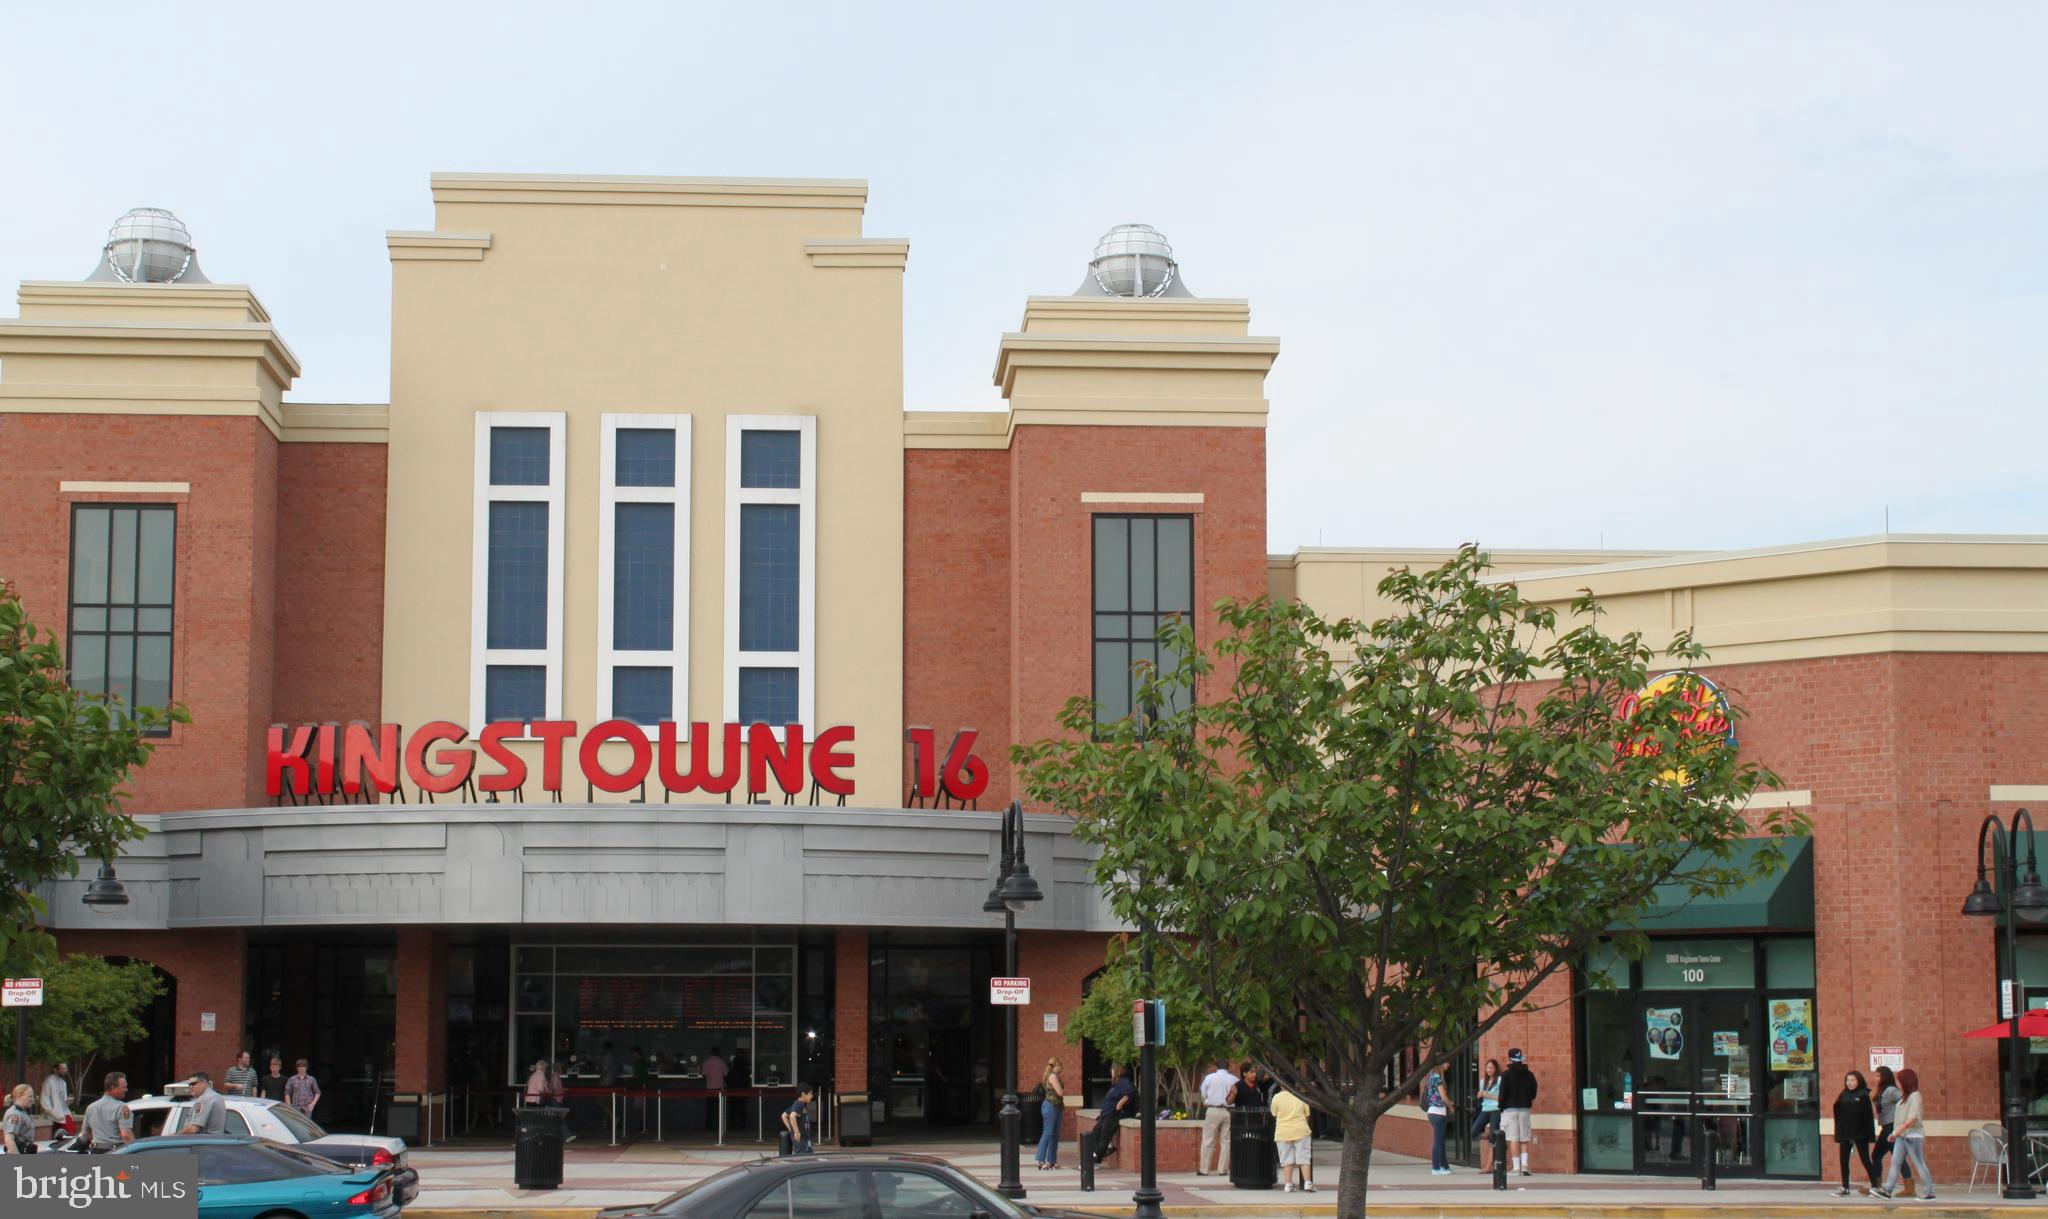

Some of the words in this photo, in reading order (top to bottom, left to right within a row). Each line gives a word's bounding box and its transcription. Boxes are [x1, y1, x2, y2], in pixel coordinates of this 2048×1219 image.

[266, 720, 855, 796] KINGSTOWNE
[906, 726, 989, 801] 16
[1682, 969, 1704, 982] 100
[1873, 1055, 1883, 1065] NO
